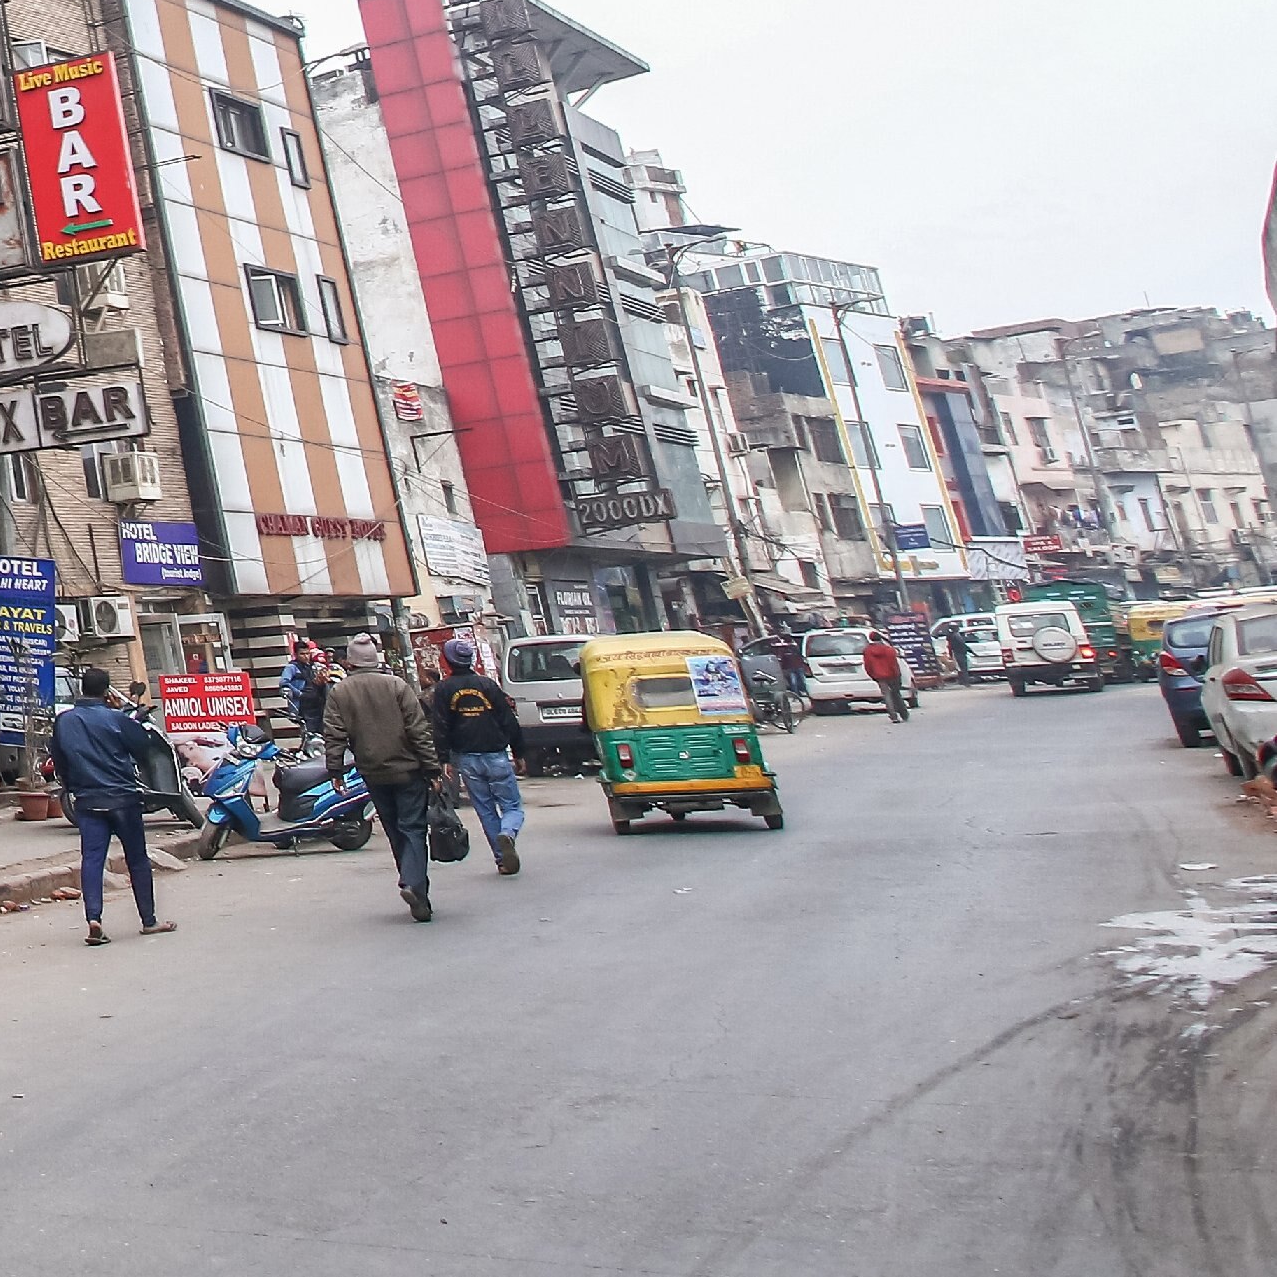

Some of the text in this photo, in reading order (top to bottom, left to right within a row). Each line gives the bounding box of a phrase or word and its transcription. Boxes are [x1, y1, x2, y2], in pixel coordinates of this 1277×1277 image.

[18, 58, 104, 92] Live Music
[48, 86, 103, 218] BAR
[43, 227, 138, 262] Restaurant
[40, 386, 136, 431] BAR
[121, 522, 157, 540] HOTEL
[134, 542, 200, 565] BRIDGE VIEW
[14, 578, 49, 592] HEART
[3, 620, 10, 631] &
[13, 621, 53, 635] TRAVELS
[164, 696, 251, 717] ANMOL UNISEX
